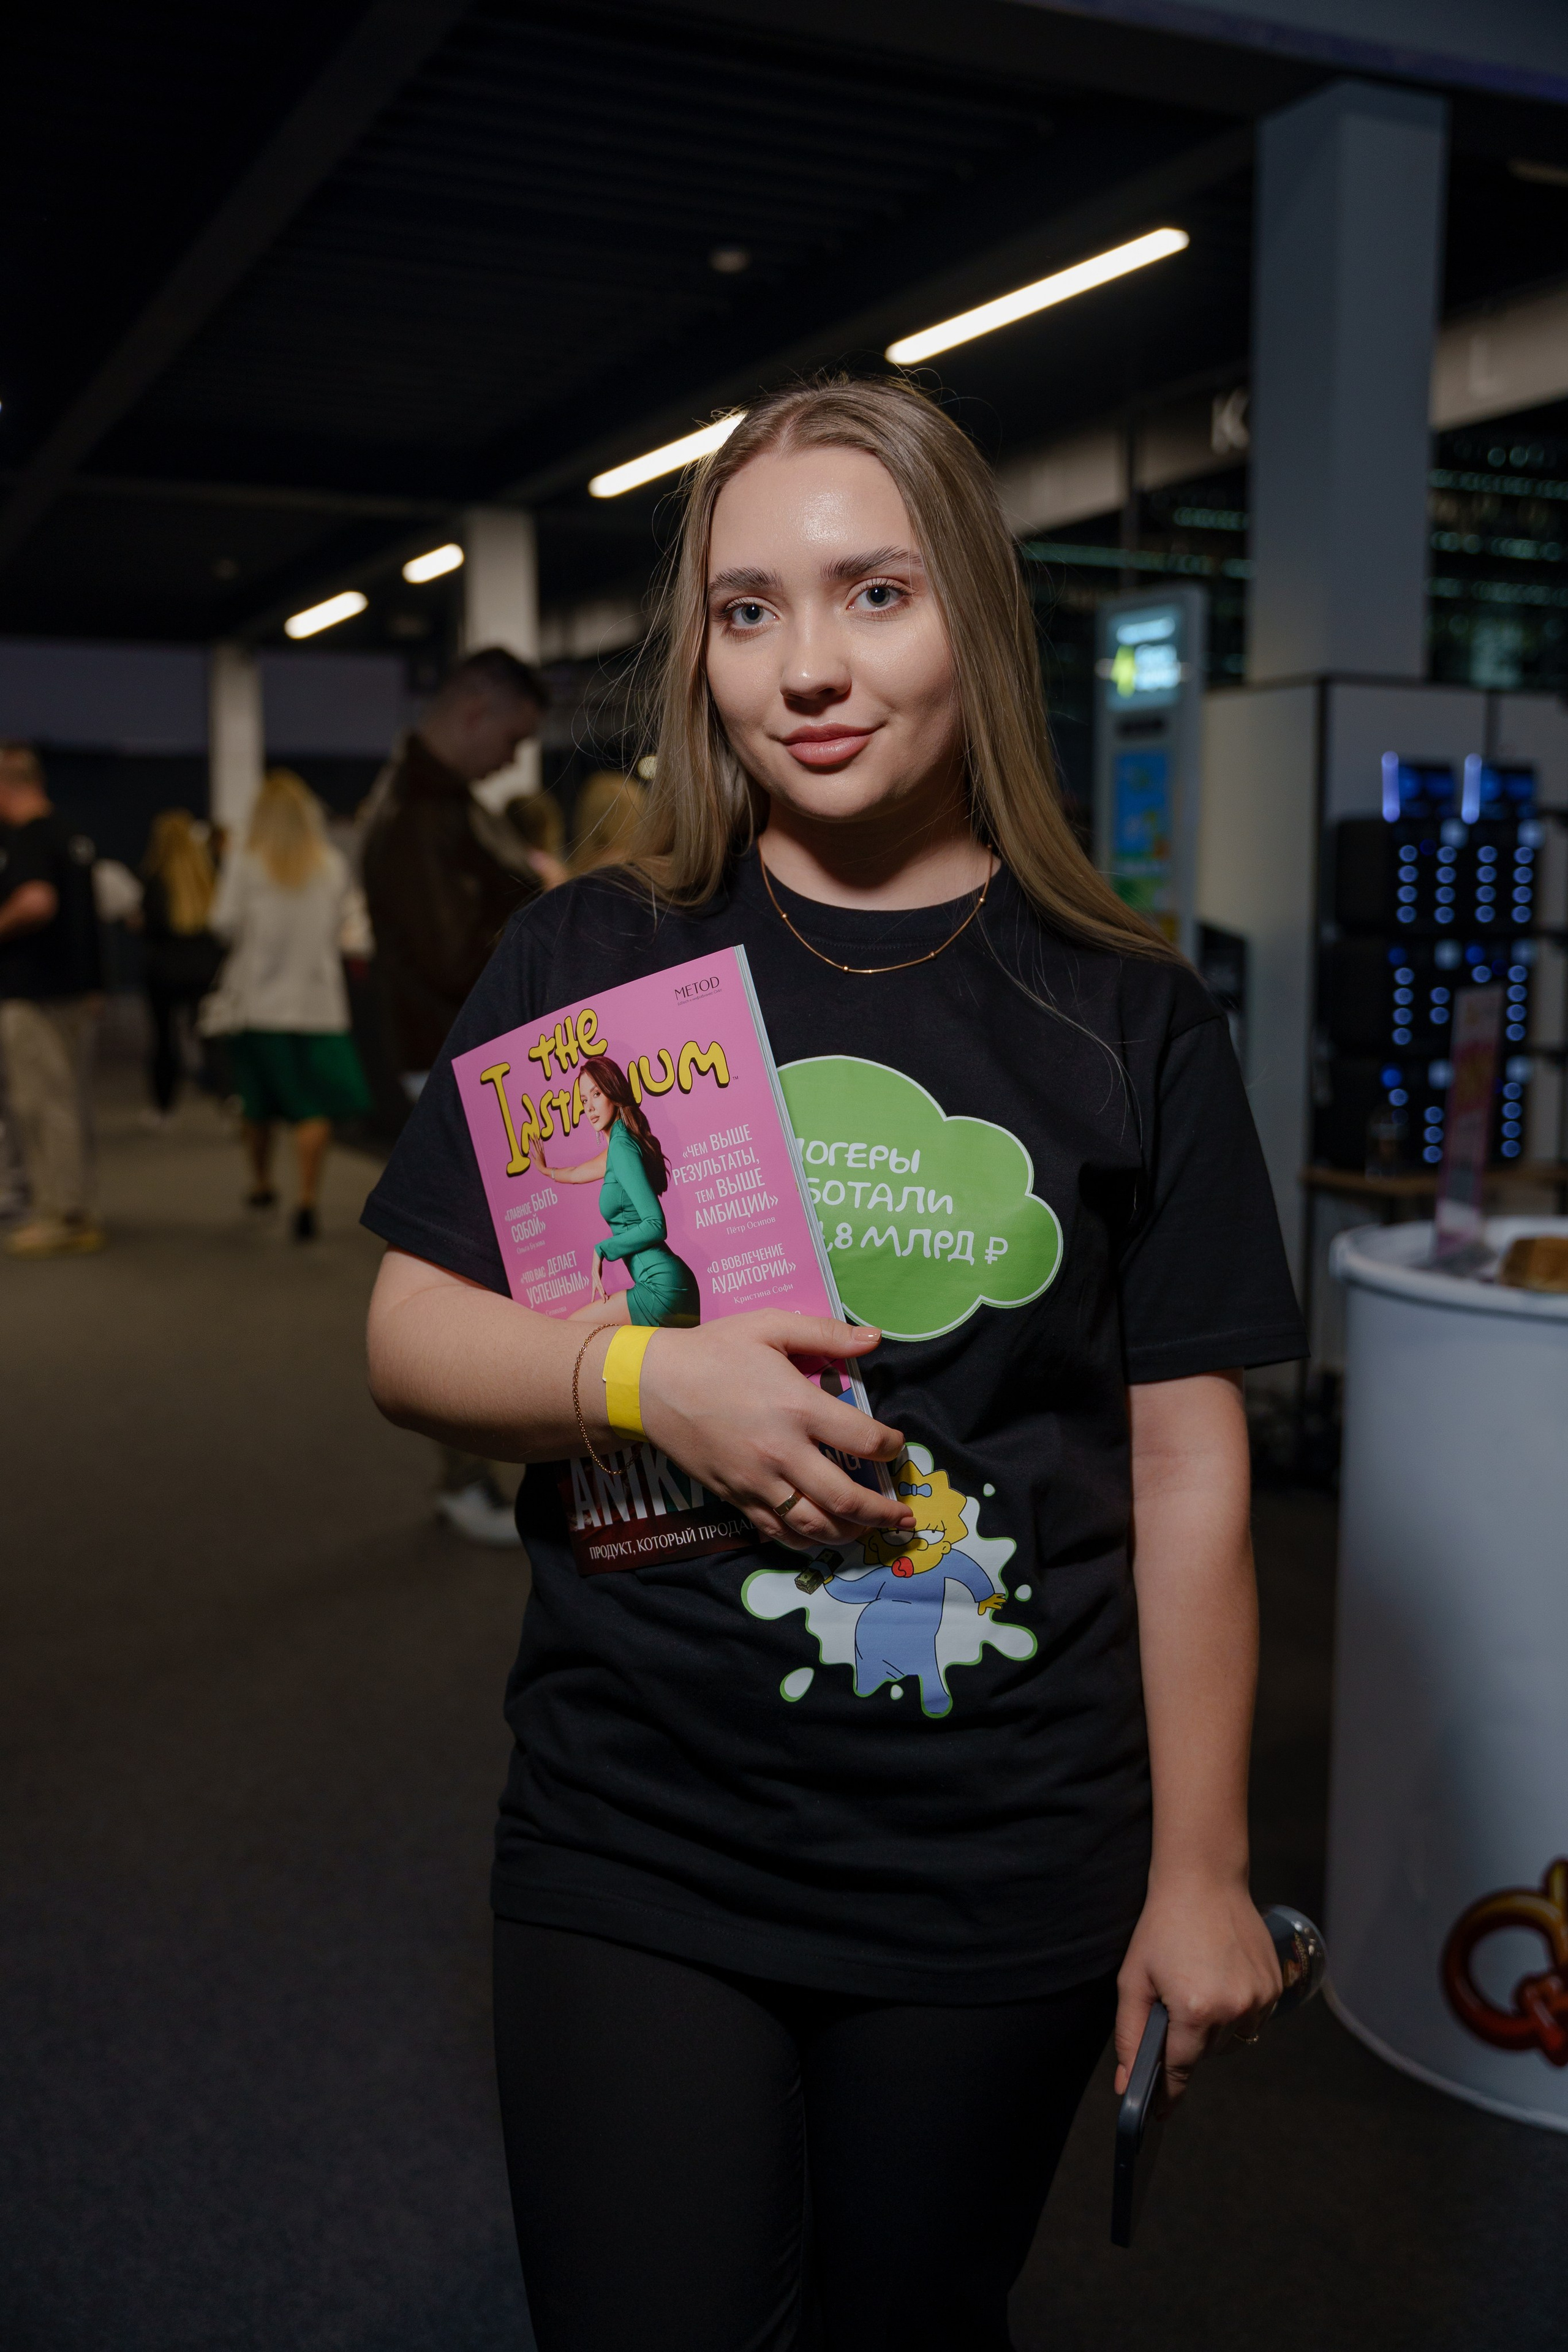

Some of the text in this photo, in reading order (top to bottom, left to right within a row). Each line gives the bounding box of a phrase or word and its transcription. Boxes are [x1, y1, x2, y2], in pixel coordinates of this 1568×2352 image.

[674, 976, 720, 1000] METOD
[682, 1124, 753, 1158] «ЧЕМ ВЫШЕ
[672, 1147, 760, 1186] РЕЗУЛЬТАТЫ,
[695, 1167, 765, 1204] ТЕМ ВЫШЕ
[505, 1188, 558, 1221] «ГЛАВНОЕ БЫТЬ
[695, 1191, 778, 1229] АМБИЦИИ»
[511, 1213, 546, 1243] СОБОЙ»
[726, 1216, 776, 1235] Пётр Осипов
[707, 1243, 785, 1274] «О ВОВЛЕЧЕНИЕ
[860, 1225, 975, 1265] МЛРД
[533, 1266, 546, 1280] ВАС
[547, 1251, 577, 1277] ДЕЛАЕТ
[712, 1258, 796, 1294] АУДИТОРИИ»
[526, 1271, 590, 1309] УСПЕШНЫМ»
[733, 1284, 794, 1304] Кристина Софи
[589, 1540, 636, 1560] ПРОДУКТ,
[636, 1527, 697, 1553] КОТОРЫЙ
